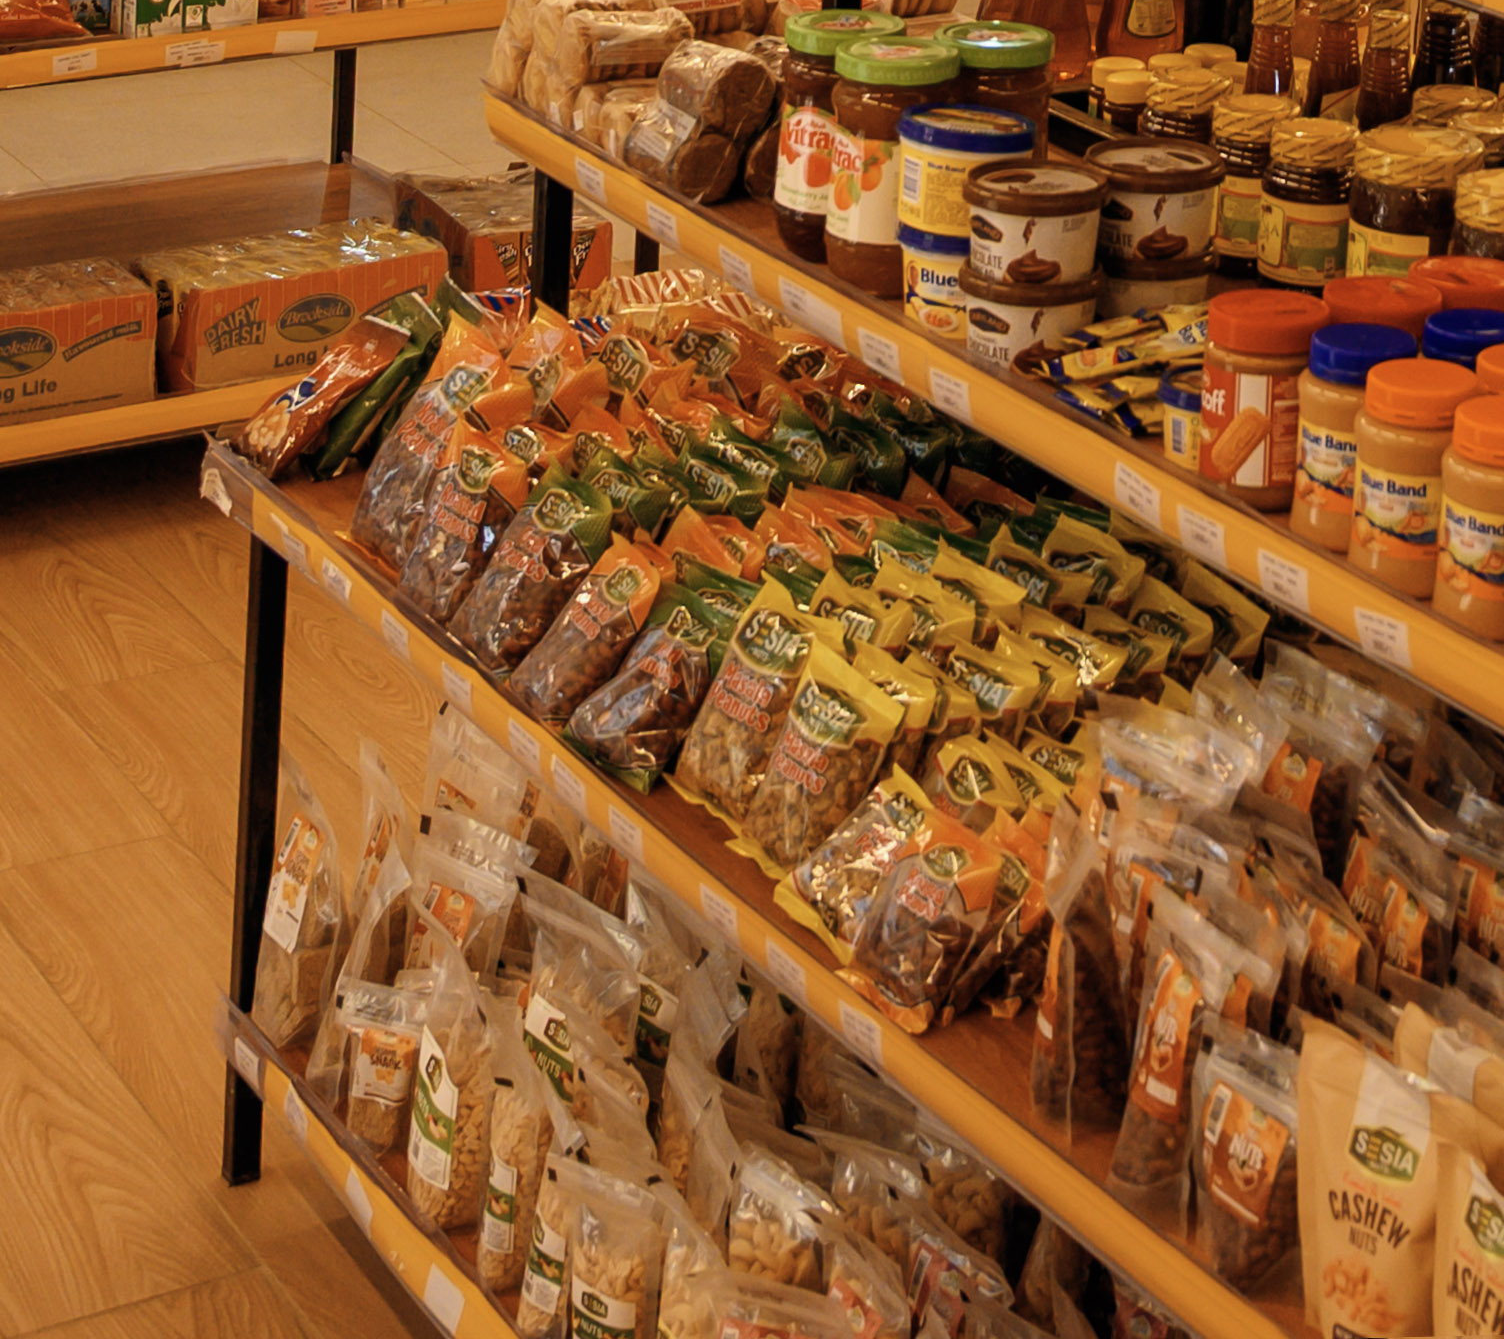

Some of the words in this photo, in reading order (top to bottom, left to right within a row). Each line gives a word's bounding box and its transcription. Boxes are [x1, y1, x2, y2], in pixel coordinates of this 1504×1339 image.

[921, 268, 959, 286] Blue
[204, 298, 261, 346] DAIRY
[280, 303, 353, 328] Brookside
[211, 322, 266, 353] FRESH
[274, 348, 318, 368] Long
[20, 377, 58, 397] Life
[1361, 472, 1384, 493] Blue
[1387, 481, 1427, 498] Band
[1446, 506, 1466, 528] Blue
[722, 662, 774, 704] Masala
[709, 683, 770, 732] Peanuts
[1353, 1131, 1415, 1177] SESIA
[1328, 1190, 1411, 1248] CASHEW
[1348, 1227, 1378, 1256] NUTS
